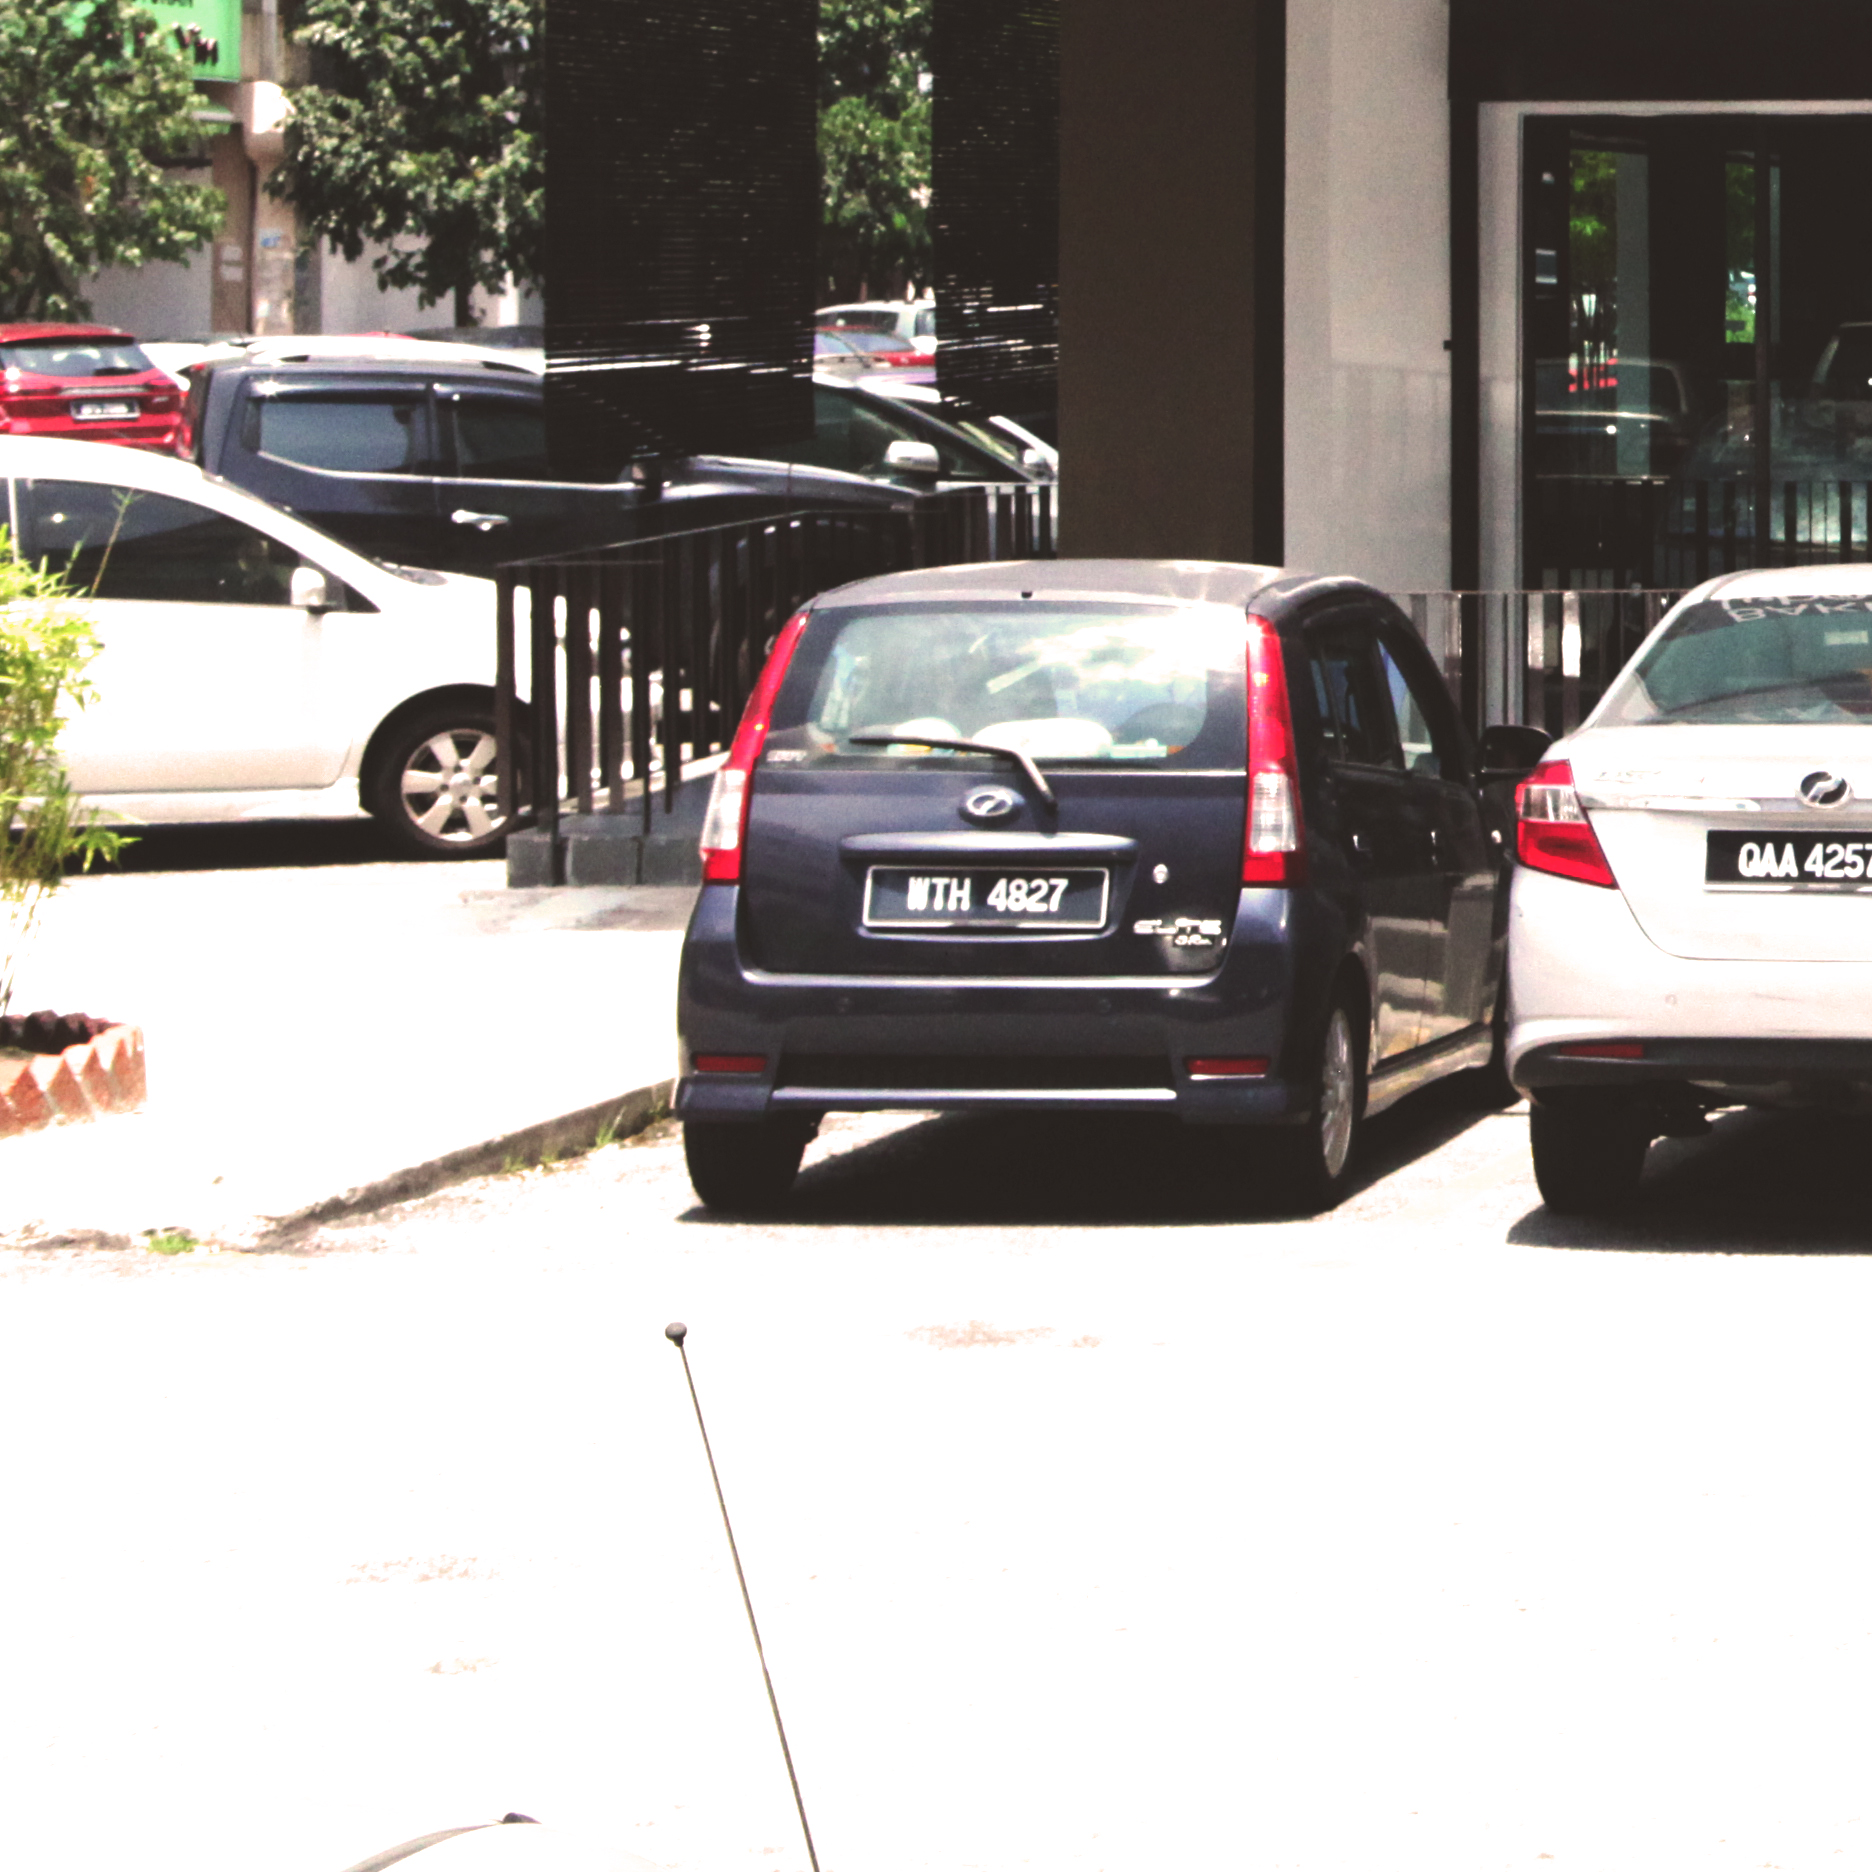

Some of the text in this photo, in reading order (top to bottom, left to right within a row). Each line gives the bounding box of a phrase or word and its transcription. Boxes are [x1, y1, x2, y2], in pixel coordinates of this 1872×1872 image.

[1738, 842, 1799, 878] QAA
[906, 876, 1070, 913] WTH 4827
